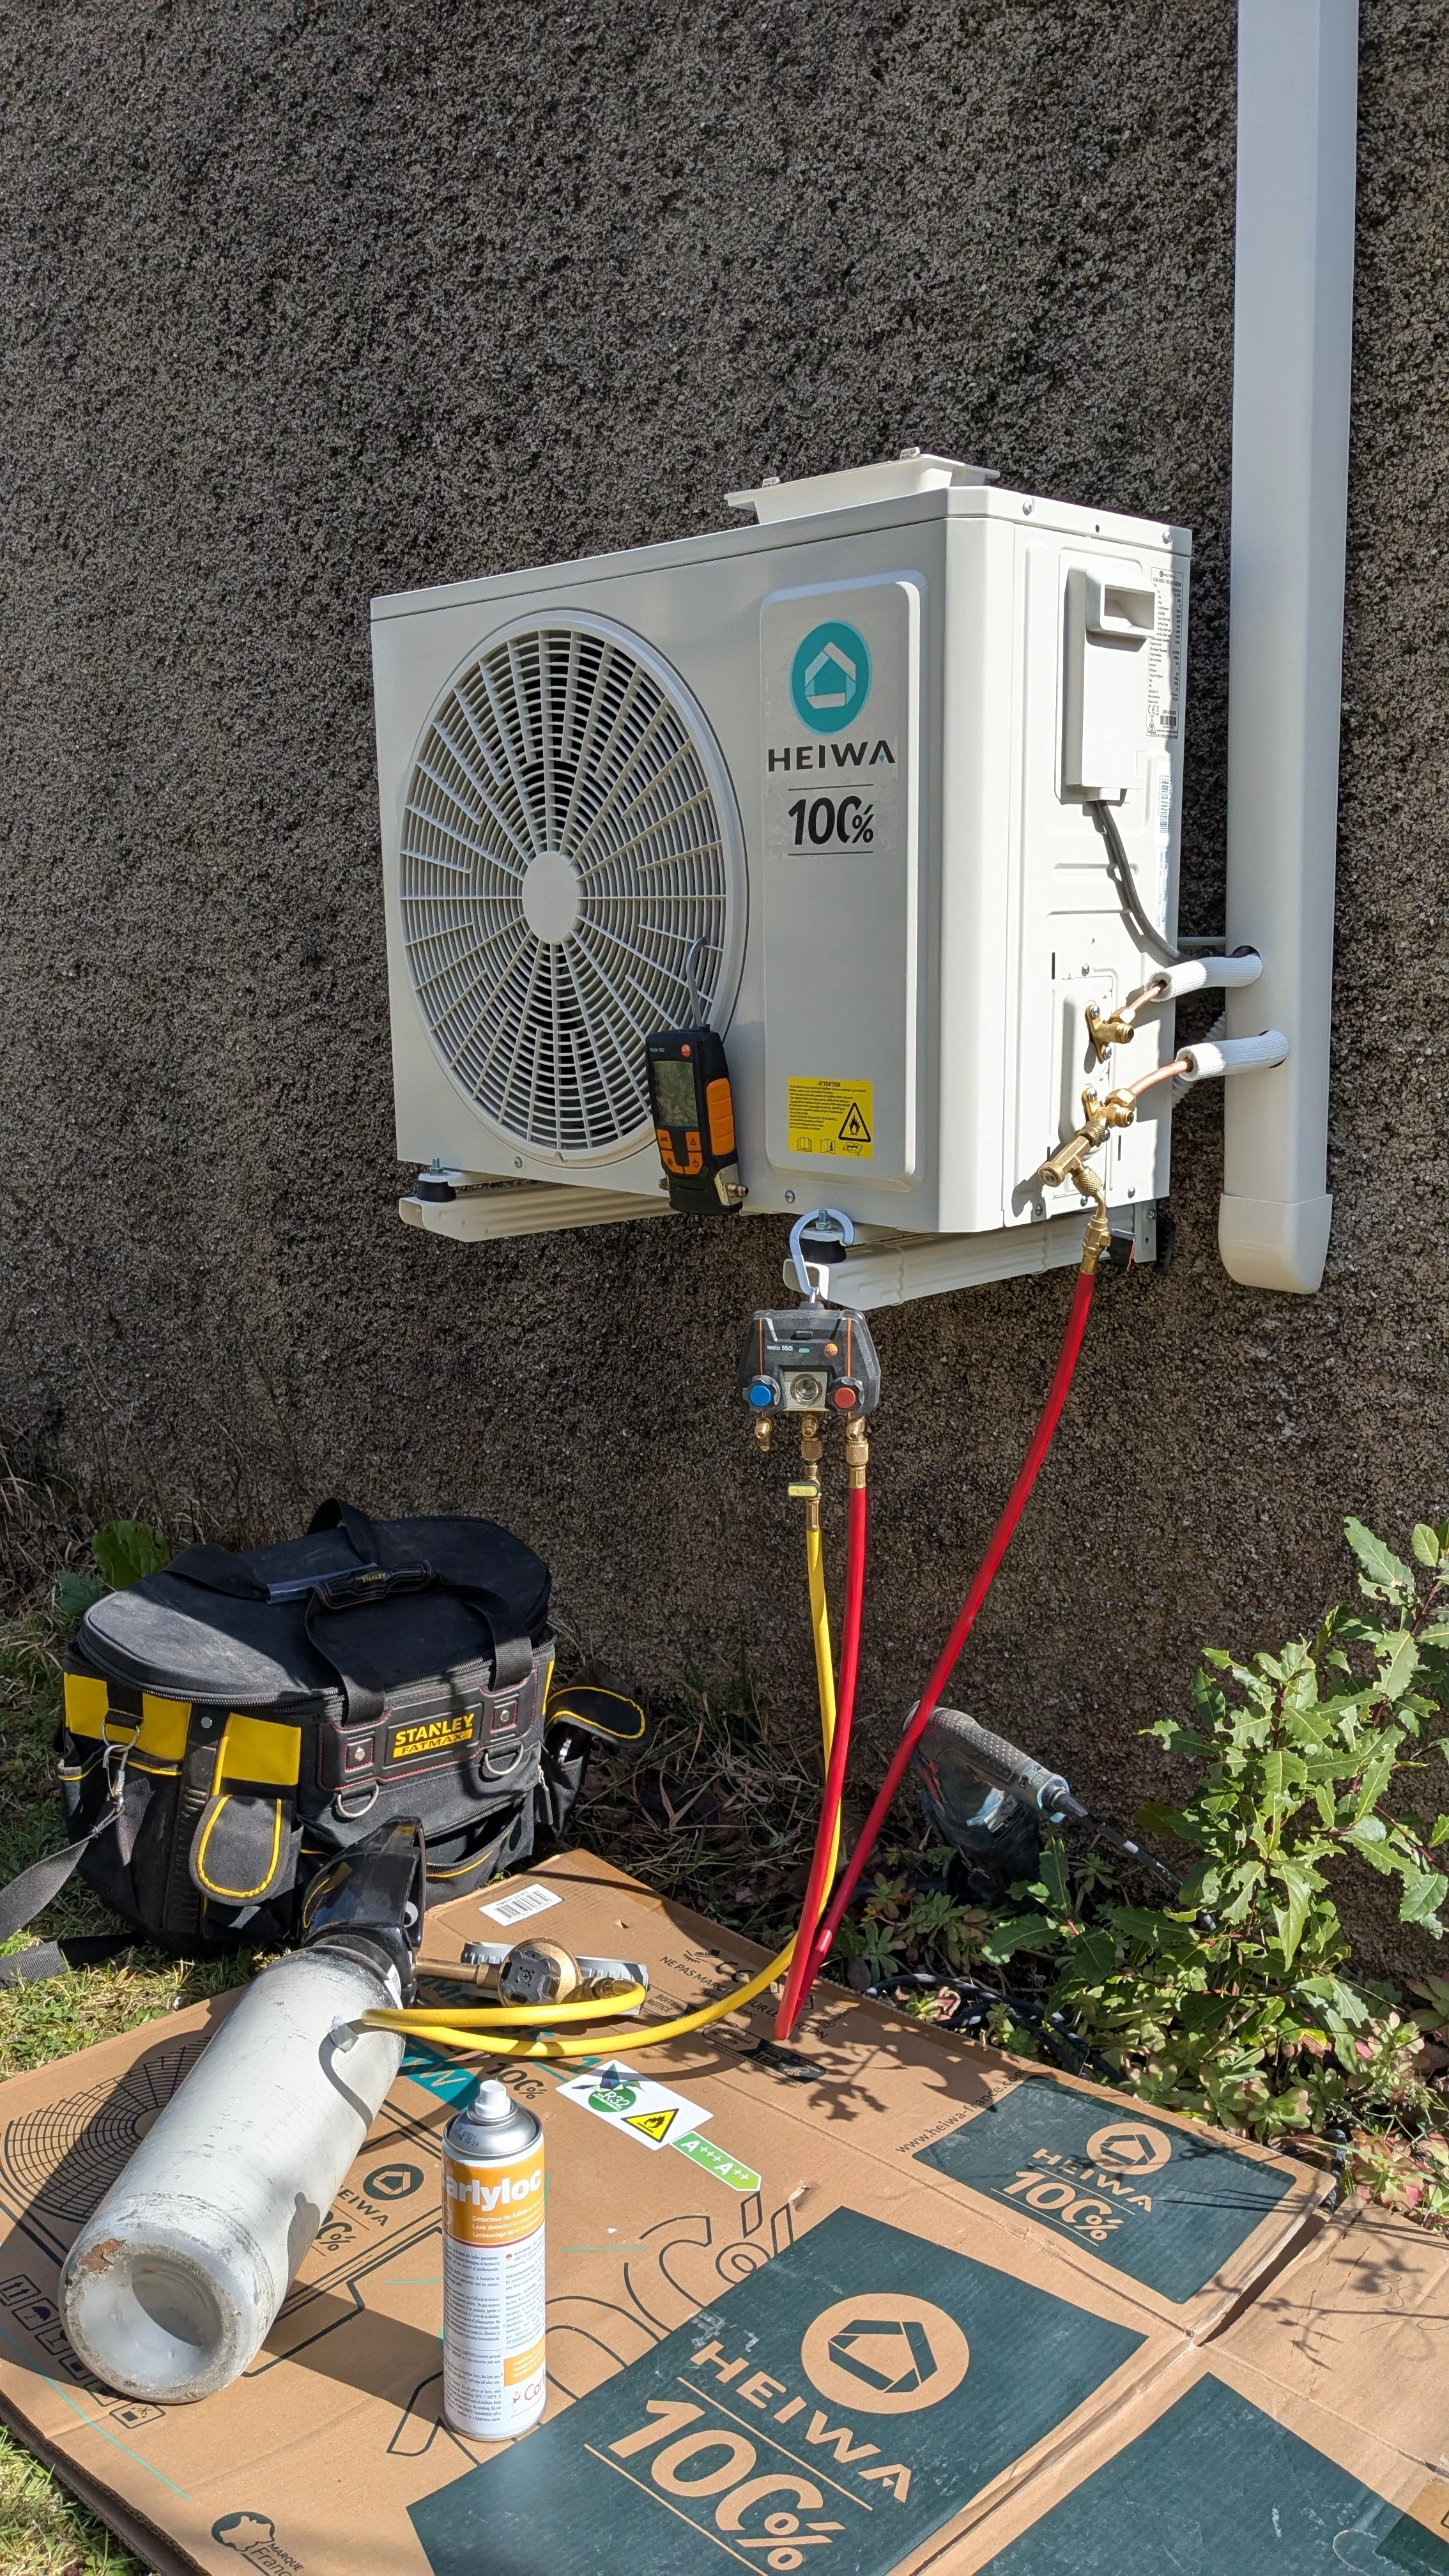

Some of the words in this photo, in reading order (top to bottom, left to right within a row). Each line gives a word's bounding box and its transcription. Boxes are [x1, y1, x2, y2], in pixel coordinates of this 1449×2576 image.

[768, 740, 896, 772] HEIWA
[362, 1572, 386, 1583] STANLEY
[395, 1713, 475, 1746] STANLEY
[402, 1733, 463, 1754] FATMAX
[646, 1998, 673, 2013] NOTICE
[654, 1994, 678, 2007] BOITE
[659, 1956, 677, 1970] NE
[675, 1960, 694, 1977] PAS
[694, 1972, 733, 1995] MARCH
[746, 1998, 768, 2013] SUR
[795, 2021, 829, 2039] RTON
[604, 2091, 631, 2106] R32
[895, 2069, 1028, 2154] www.heiwa-france.com
[443, 2169, 542, 2211] arlyloc
[1031, 2147, 1153, 2214] HEIWA
[337, 2185, 389, 2227] EIWA
[512, 2209, 528, 2220] fuites
[487, 2222, 512, 2230] detector
[689, 2340, 913, 2504] HEIWA
[250, 2547, 293, 2576] Franc
[267, 2543, 304, 2572] MARQUE
